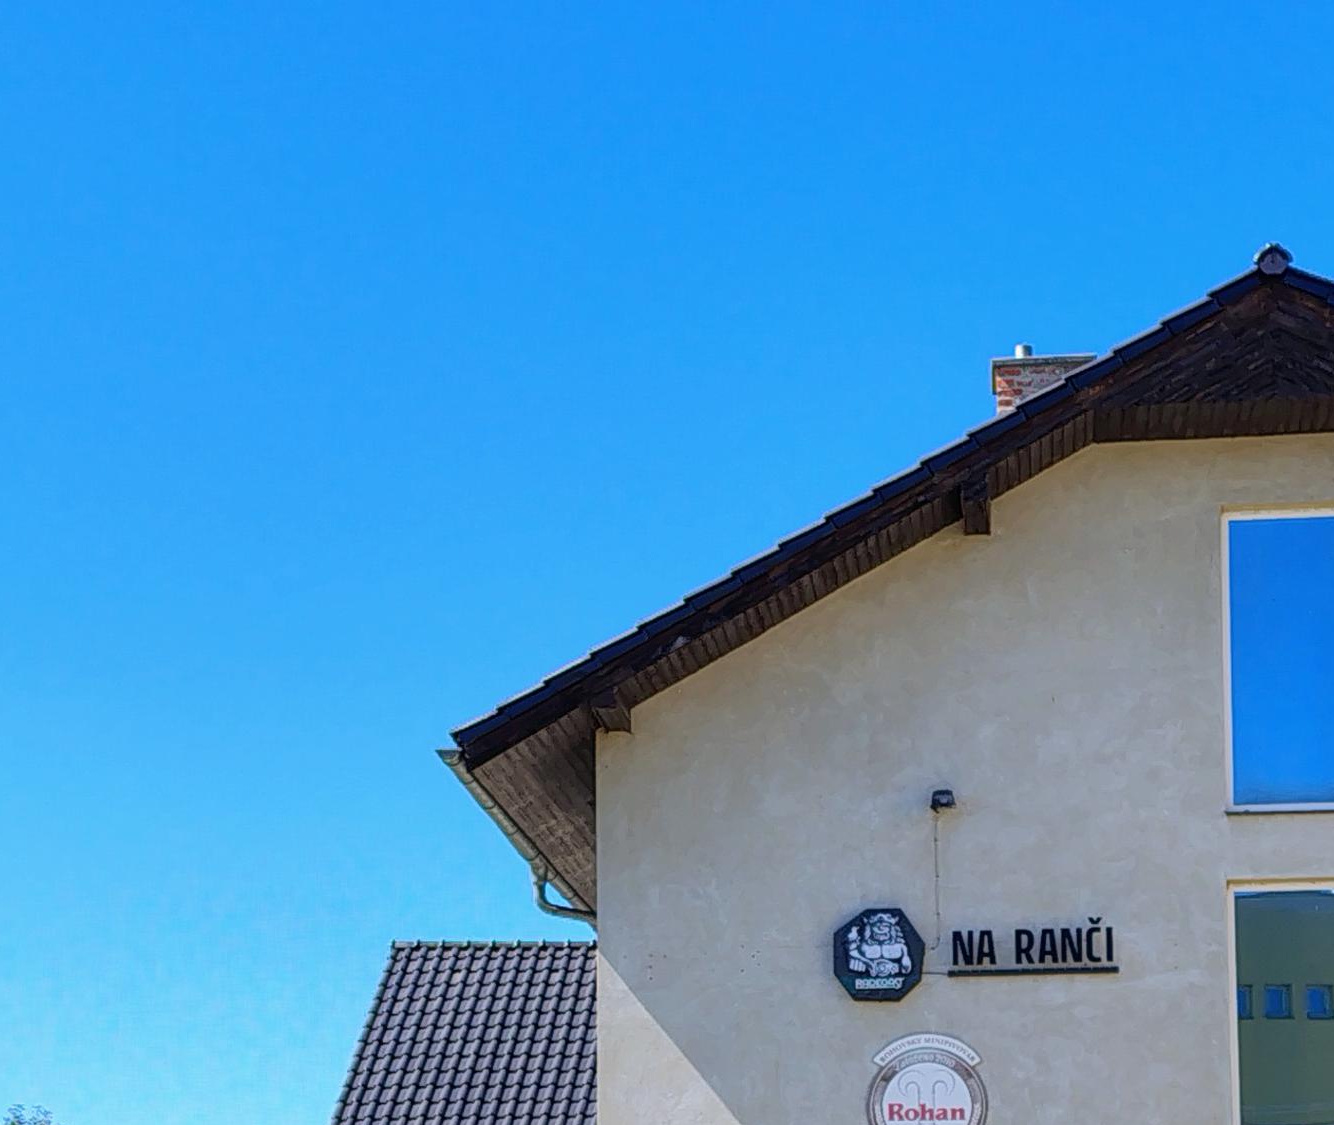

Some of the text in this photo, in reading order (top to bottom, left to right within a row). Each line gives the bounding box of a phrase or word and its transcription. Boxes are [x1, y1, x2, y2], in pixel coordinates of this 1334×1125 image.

[952, 916, 1114, 966] NA RANČI
[887, 1103, 965, 1121] Rohan
